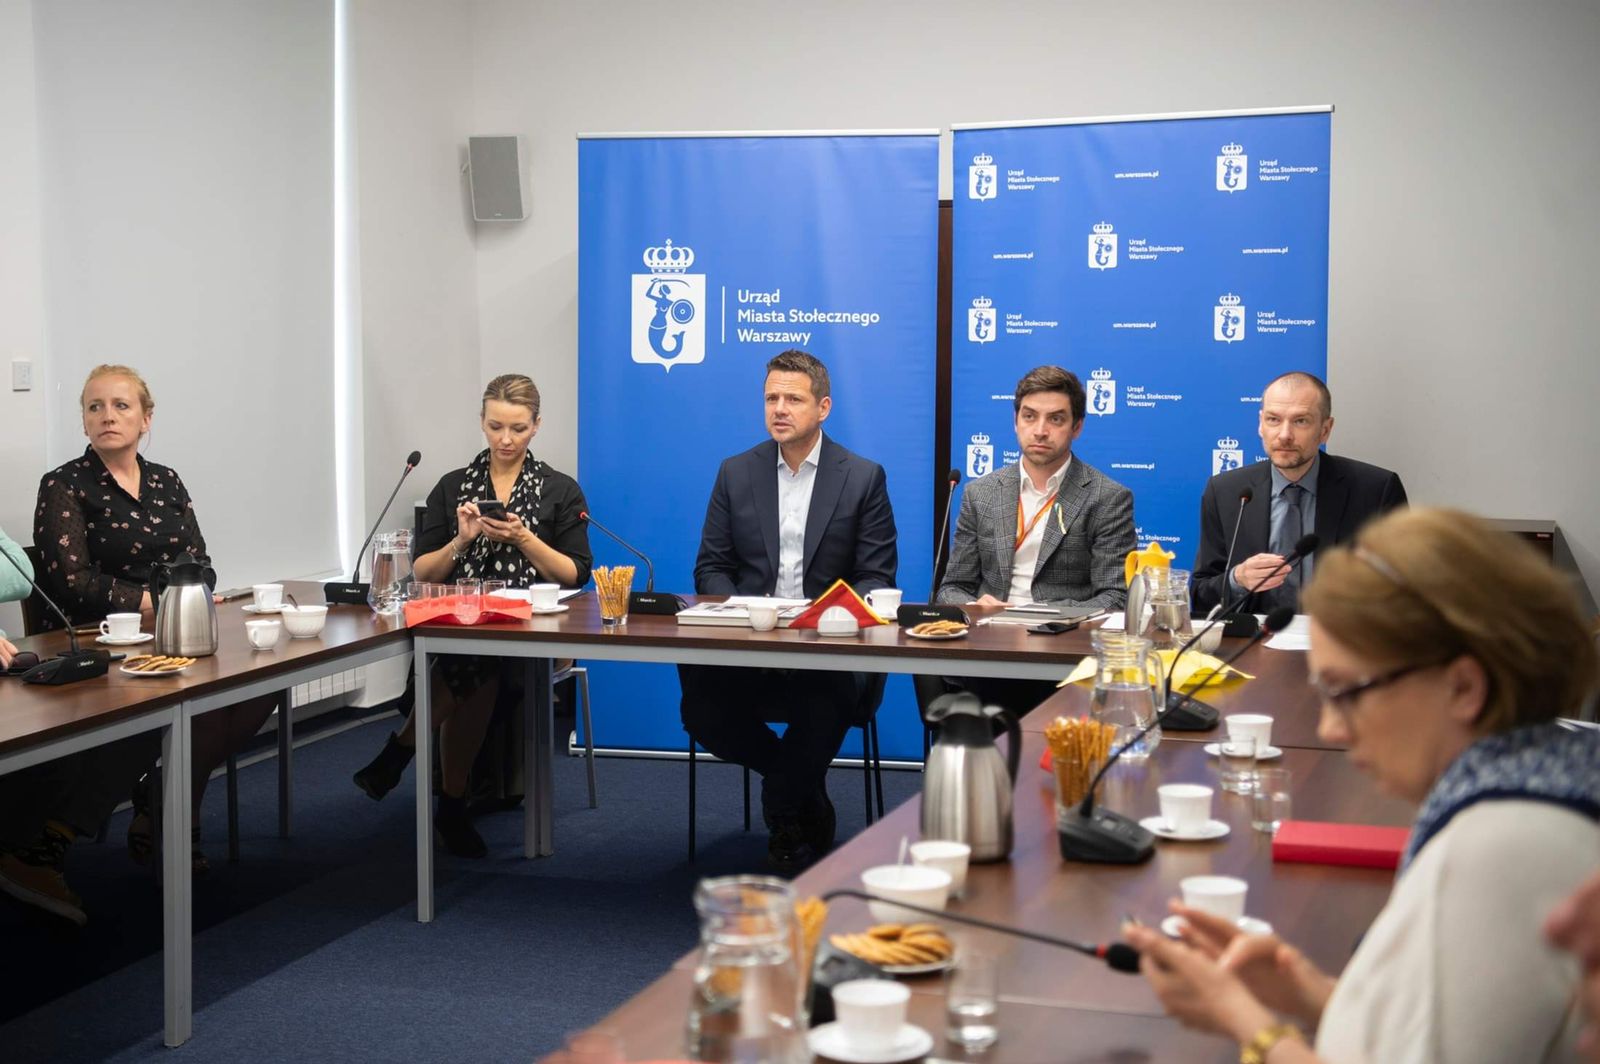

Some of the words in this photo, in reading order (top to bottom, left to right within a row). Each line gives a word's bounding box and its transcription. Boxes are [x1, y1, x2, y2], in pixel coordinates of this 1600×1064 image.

[1129, 253, 1158, 261] Warszawy
[738, 289, 780, 307] Urząd
[738, 309, 786, 323] Miasta
[789, 308, 880, 327] Stołecznego
[1257, 326, 1288, 334] Warszawy
[737, 329, 811, 346] Warszawy
[1126, 400, 1156, 408] Warszawy
